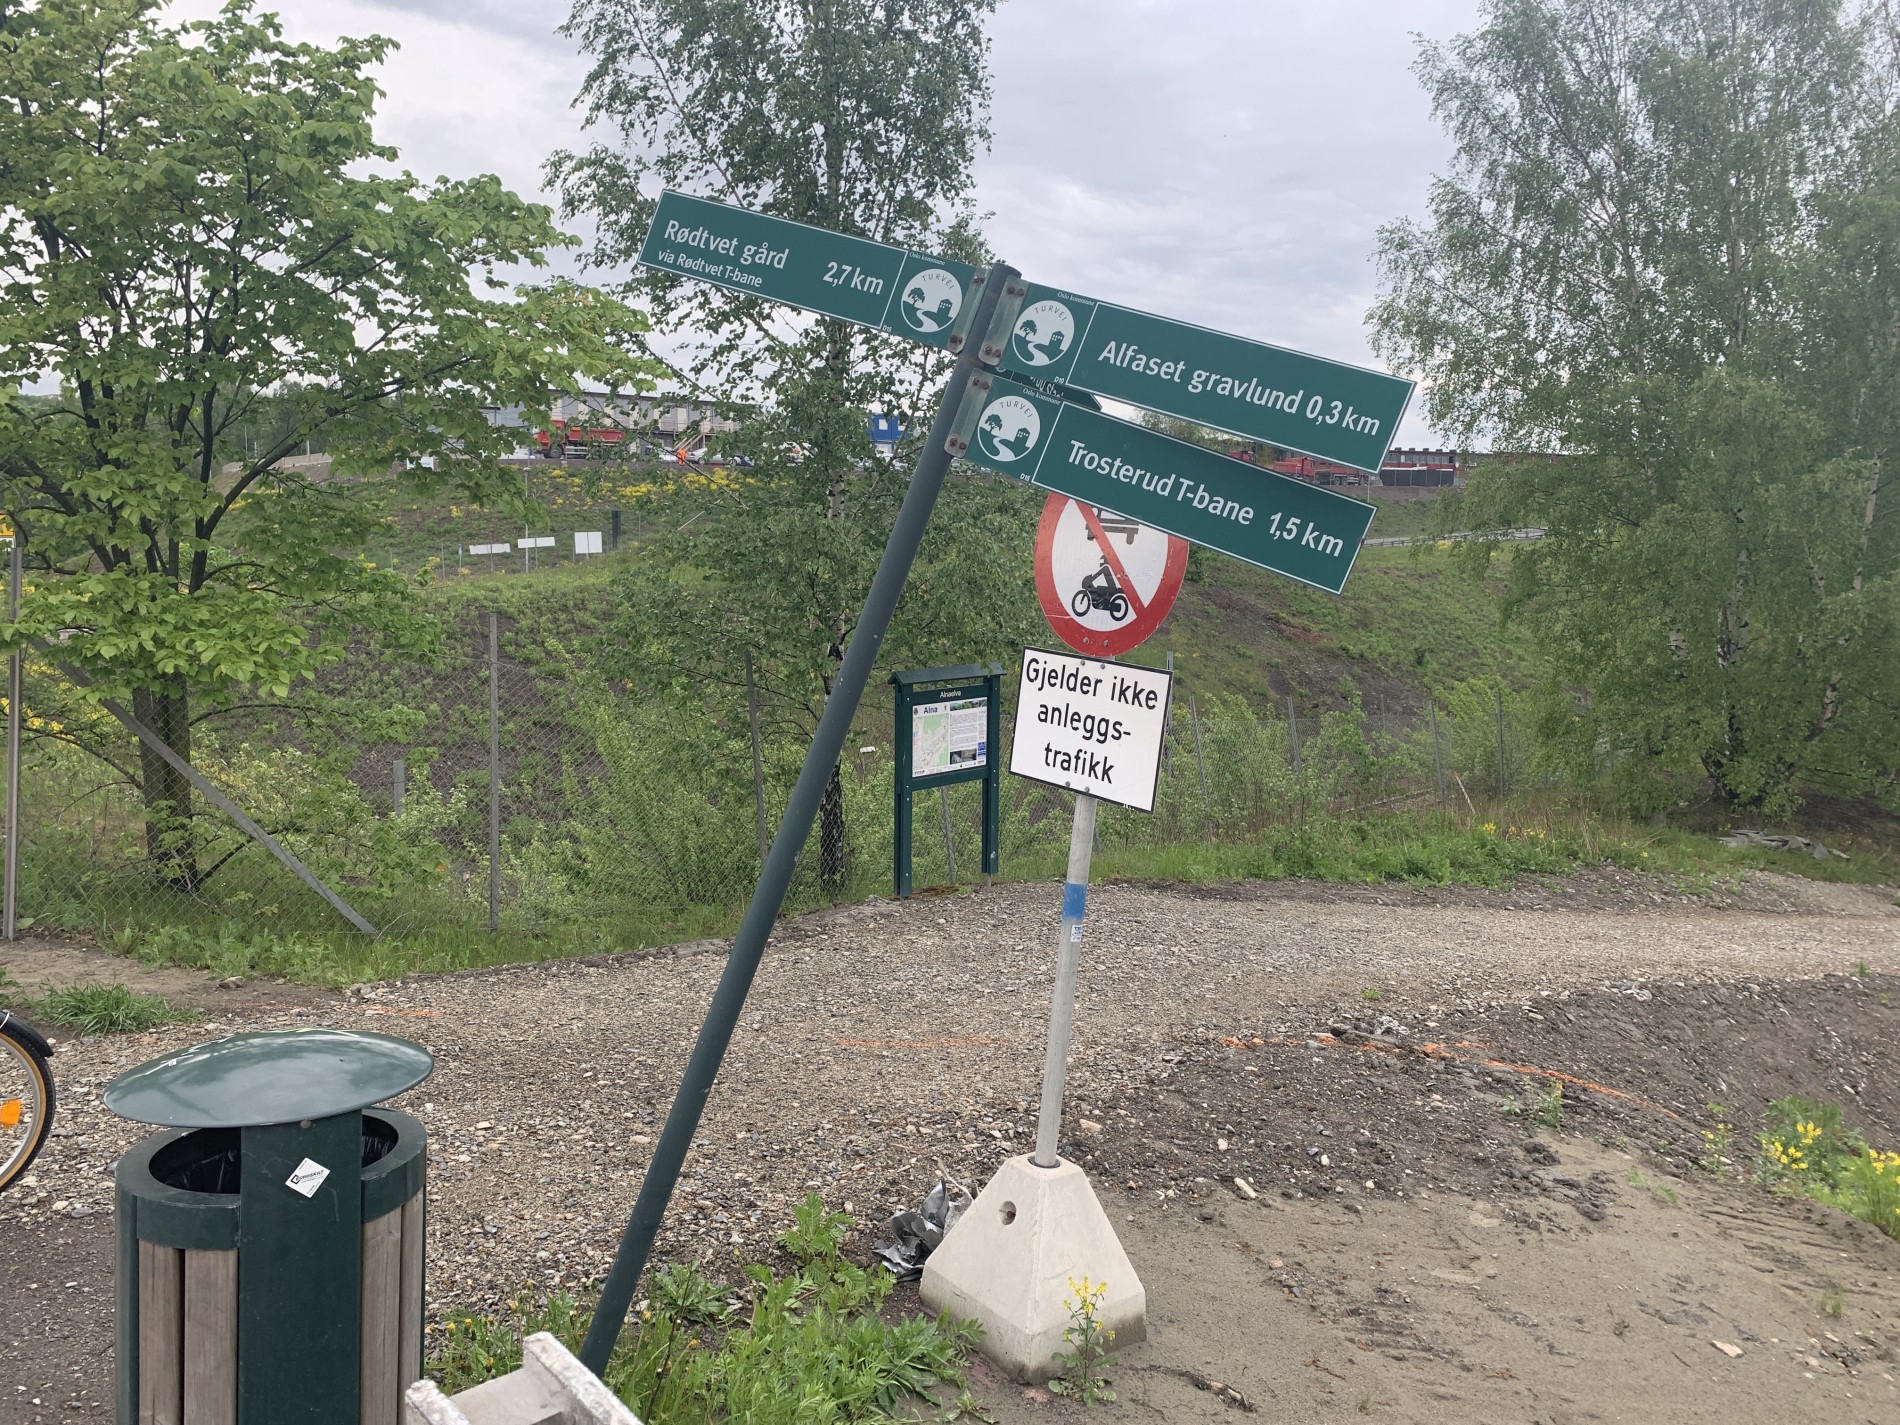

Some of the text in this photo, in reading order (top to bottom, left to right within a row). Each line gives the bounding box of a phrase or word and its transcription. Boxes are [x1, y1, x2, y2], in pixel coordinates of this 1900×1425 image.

[664, 219, 789, 269] Rødtvet gård
[909, 251, 921, 260] Oslo
[657, 249, 763, 288] via Rødtvet T-bane
[822, 261, 885, 295] 2,7 km
[921, 273, 955, 290] TURVEI
[1034, 304, 1068, 321] TURVEI
[1057, 291, 1070, 300] Oslo
[1022, 387, 1035, 397] Oslo
[1098, 341, 1382, 436] Alfaset gravlund 0,3 km
[999, 400, 1034, 418] TURVEI
[1068, 439, 1344, 558] Trosterud T-bane 1,5 km
[1026, 658, 1158, 710] Gjelder ikke
[923, 705, 939, 715] Alna
[1037, 703, 1132, 744] anleggs-
[1044, 742, 1115, 784] trafikk
